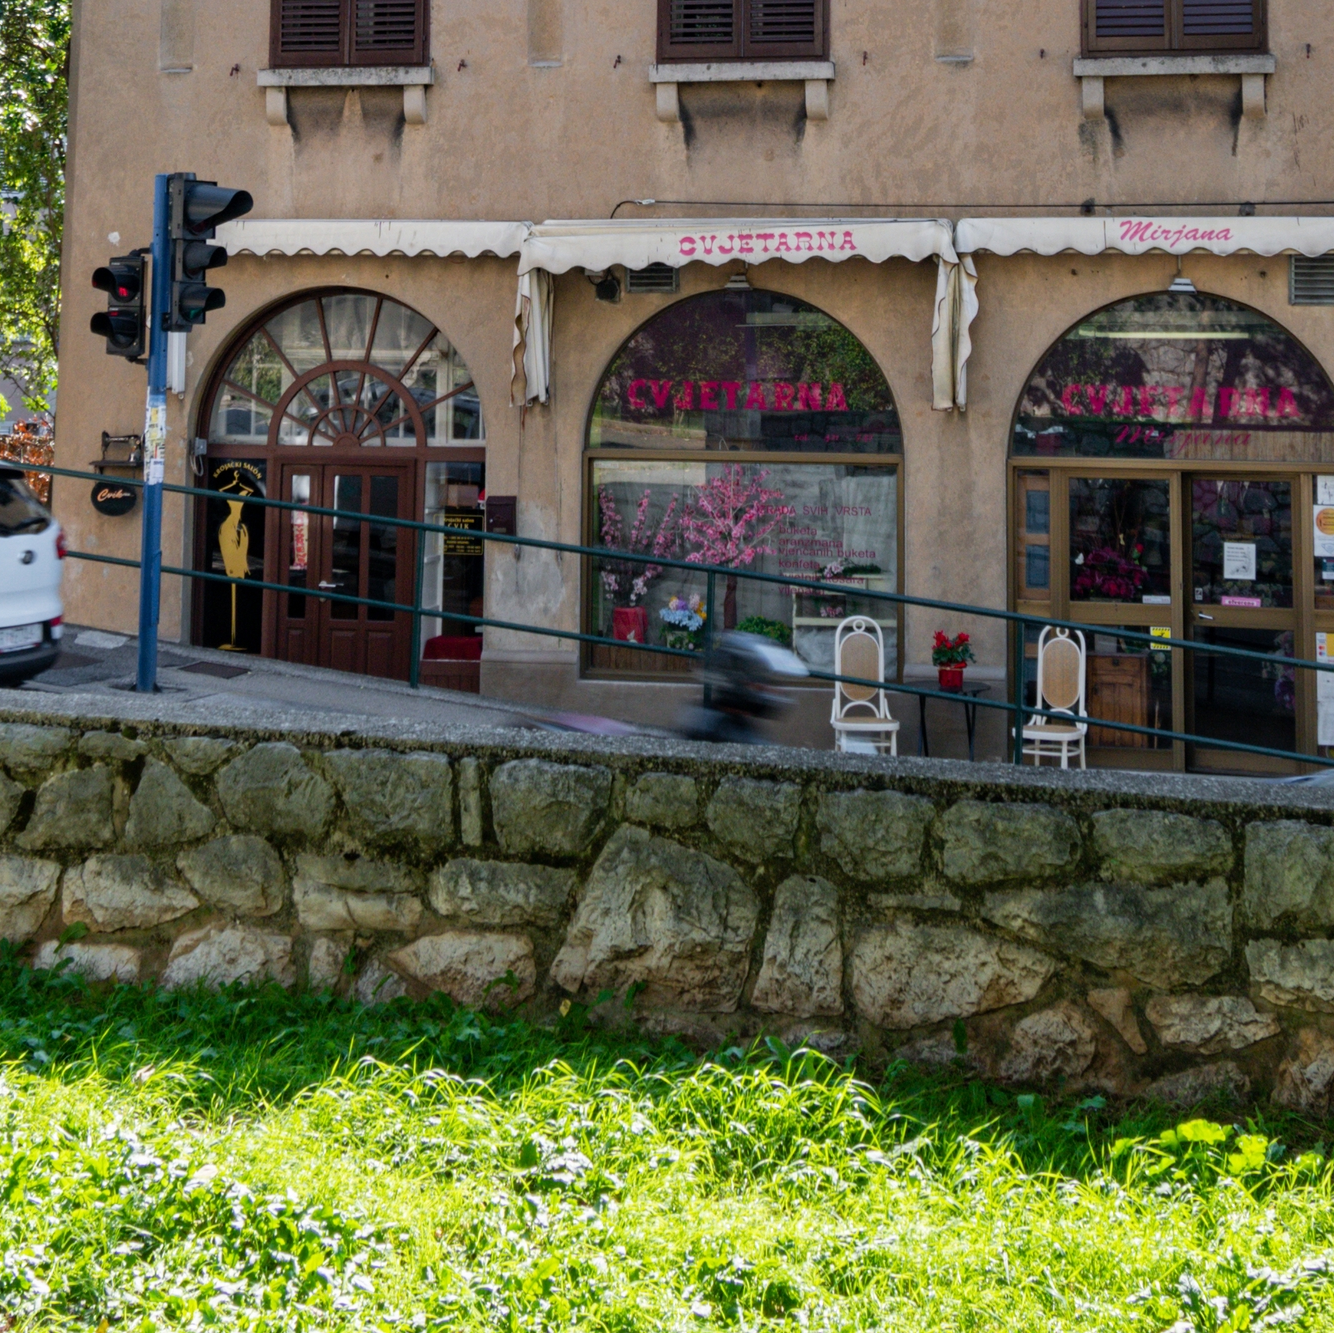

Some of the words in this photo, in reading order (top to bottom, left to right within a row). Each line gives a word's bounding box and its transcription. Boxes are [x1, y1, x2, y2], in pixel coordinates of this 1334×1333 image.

[679, 231, 858, 256] CVJETARNA
[1119, 220, 1233, 248] Mirjana
[627, 379, 849, 412] CVJETARNA
[1062, 384, 1301, 417] CVJETARNA
[1114, 423, 1252, 457] Mirjana
[803, 506, 828, 516] SVIH
[835, 506, 872, 516] VRSTA
[778, 523, 817, 535] buketa
[837, 548, 876, 559] buketa
